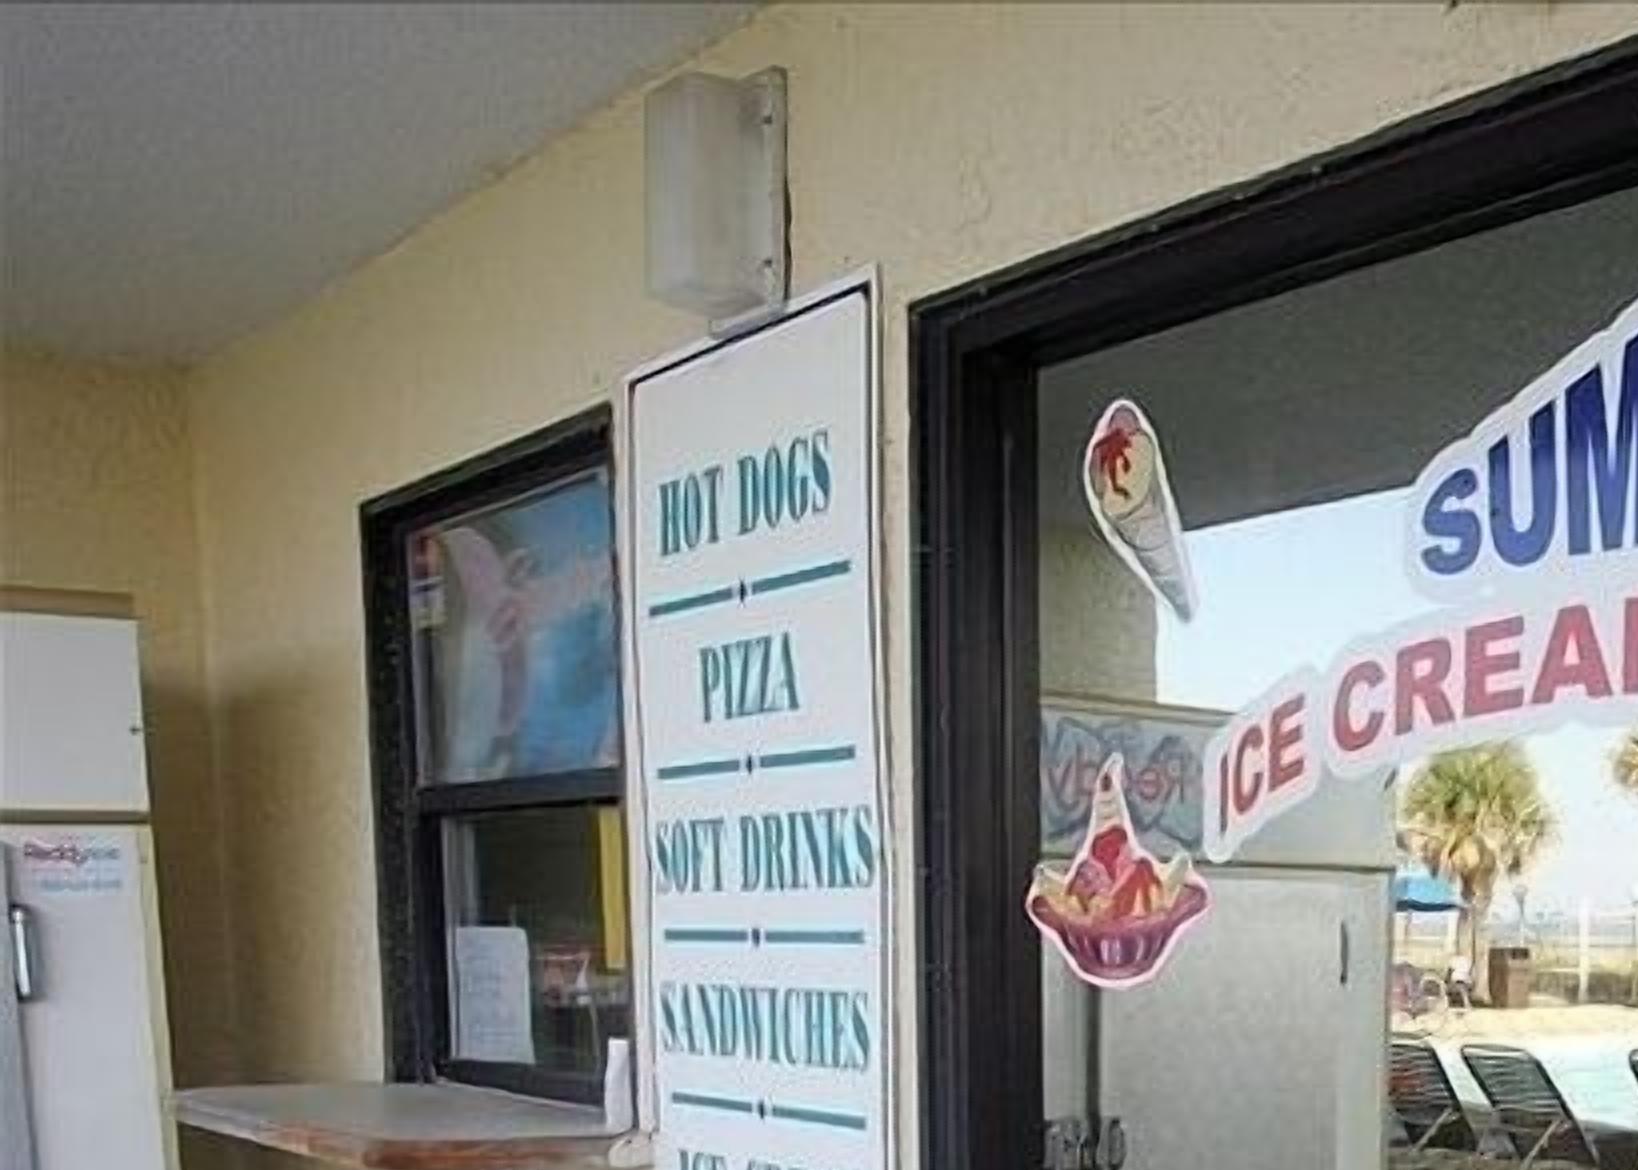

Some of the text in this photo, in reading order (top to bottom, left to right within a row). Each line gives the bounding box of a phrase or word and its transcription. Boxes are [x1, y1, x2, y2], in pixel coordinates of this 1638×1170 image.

[659, 429, 832, 557] HOT DOGS
[699, 632, 800, 723] PIZZA
[1219, 692, 1305, 838] ICE
[655, 804, 874, 895] SOFT DRINKS
[659, 981, 869, 1073] SANDWICHES
